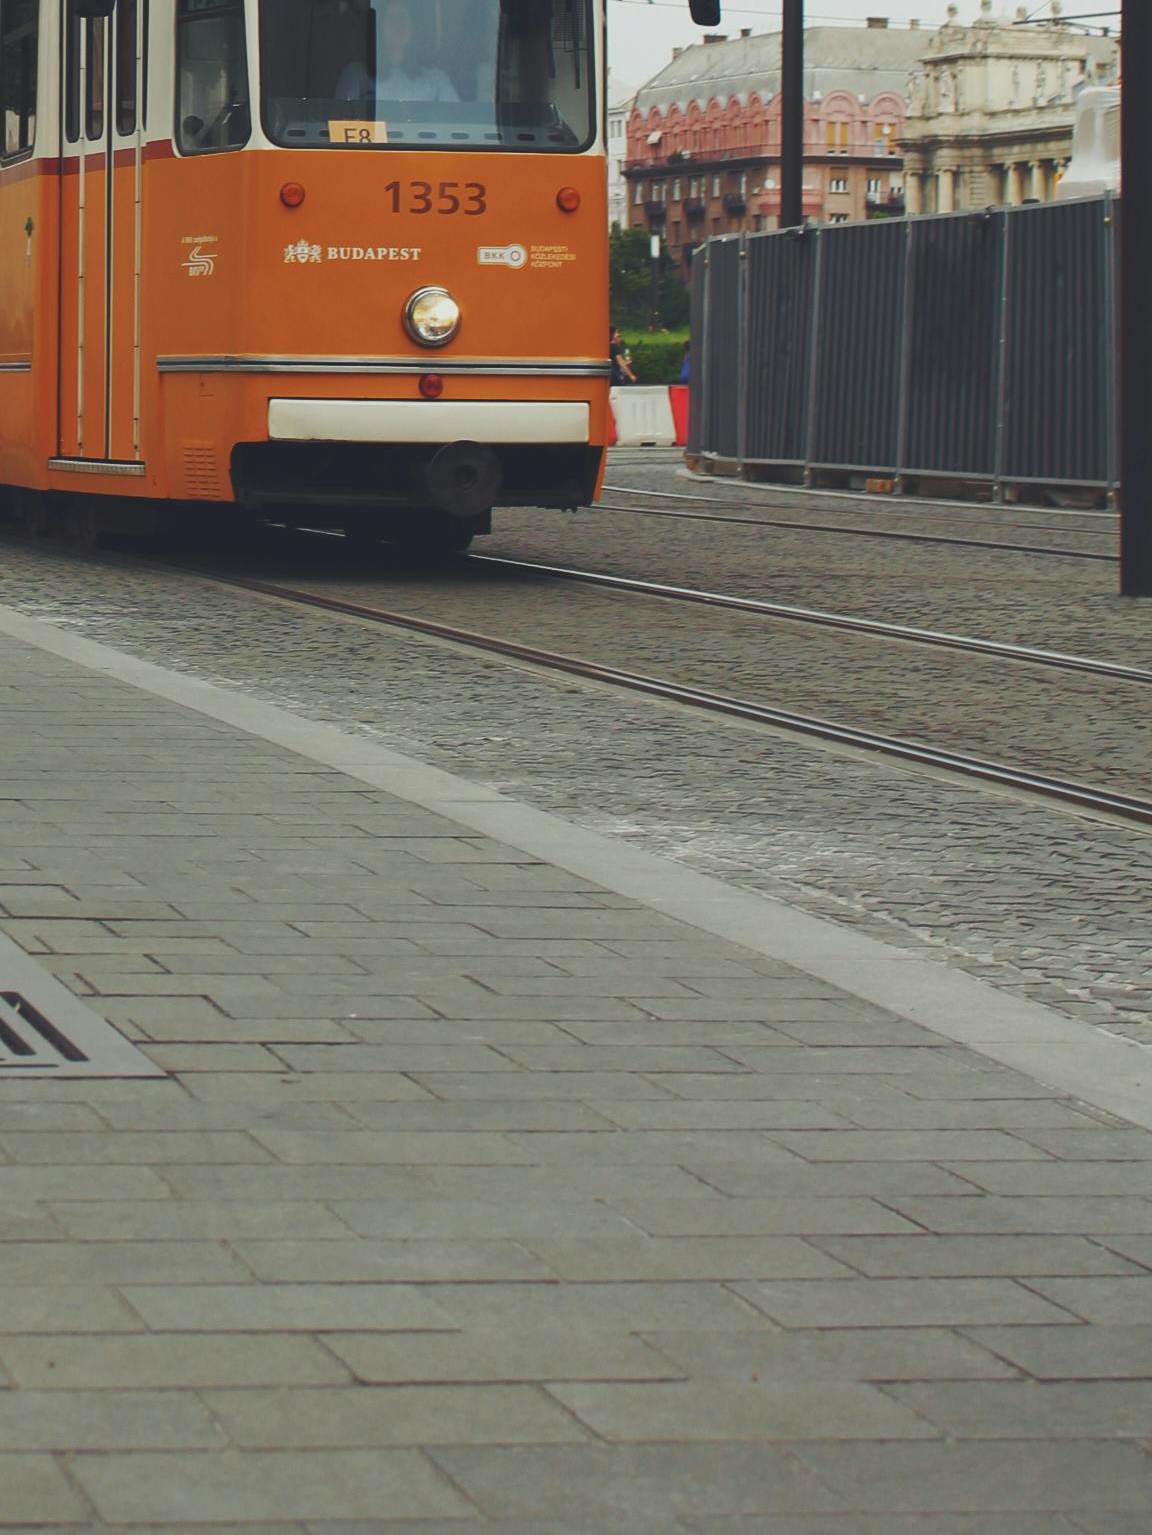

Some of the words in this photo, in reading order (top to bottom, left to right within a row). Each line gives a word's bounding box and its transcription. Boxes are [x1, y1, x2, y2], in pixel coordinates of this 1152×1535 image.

[385, 181, 487, 215] 1353
[327, 247, 422, 261] BUDAPEST
[484, 252, 505, 260] BKK
